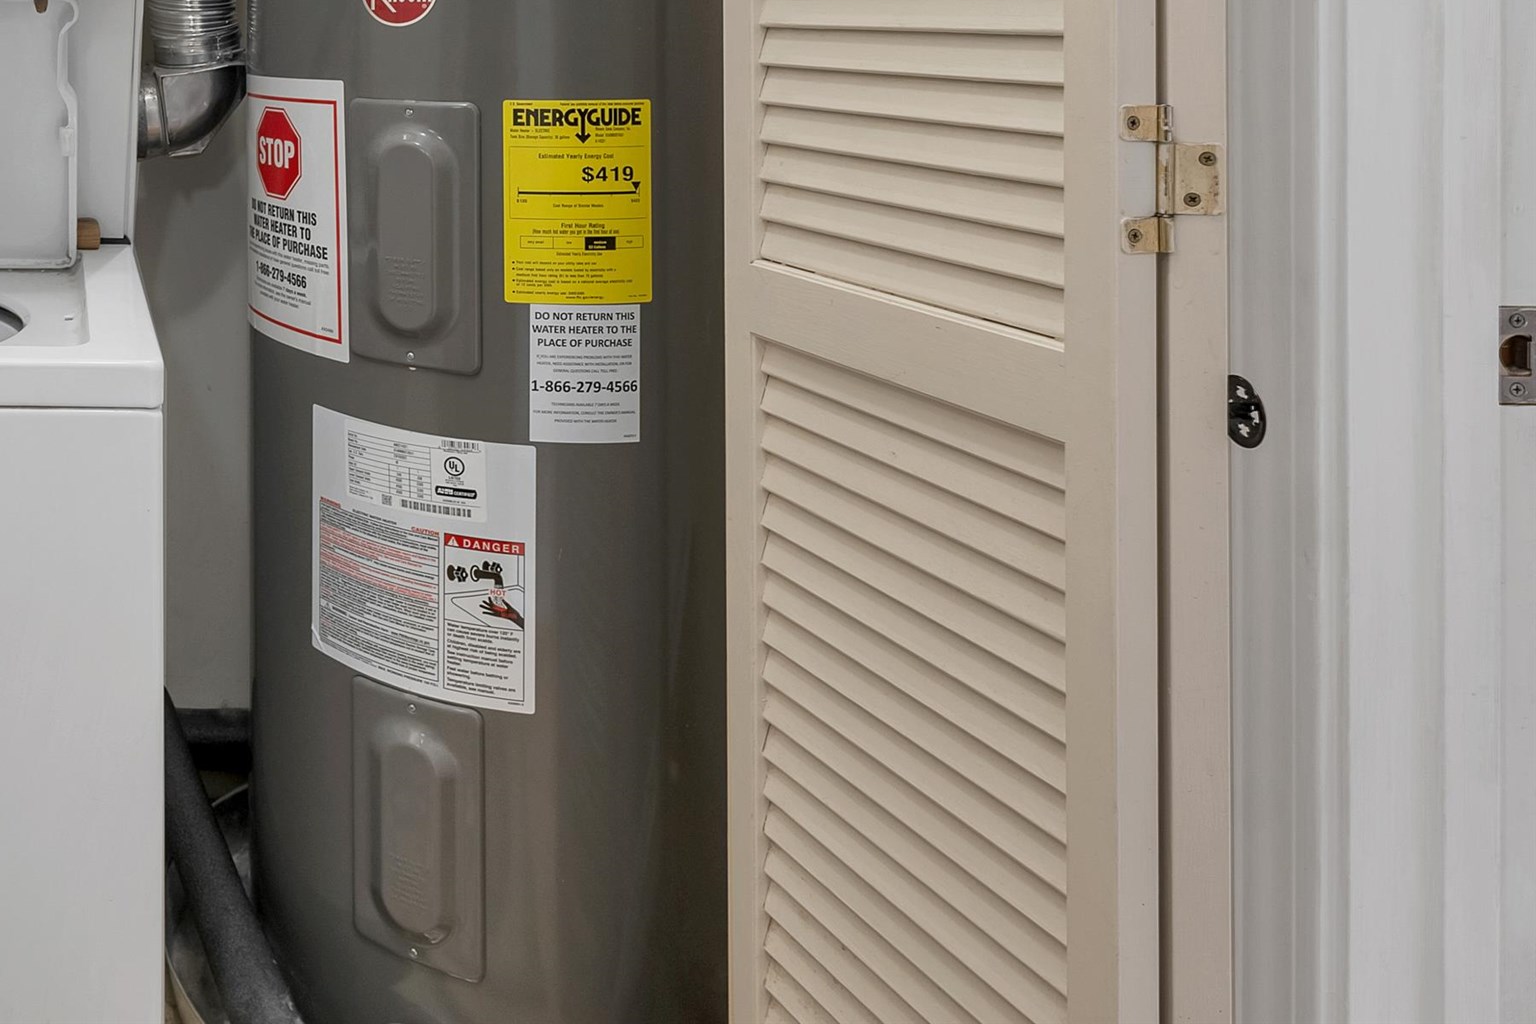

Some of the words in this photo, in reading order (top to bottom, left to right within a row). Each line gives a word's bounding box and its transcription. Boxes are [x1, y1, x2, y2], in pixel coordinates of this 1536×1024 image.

[512, 108, 642, 126] ENERGYGUIDE
[259, 135, 295, 170] STOP
[582, 166, 634, 183] $419
[258, 200, 266, 214] NOT
[268, 203, 295, 222] RETURN
[296, 210, 317, 226] THIS
[254, 213, 269, 230] WATER
[270, 219, 298, 238] HEATER
[300, 226, 311, 241] TO
[256, 228, 271, 246] PLACE
[272, 235, 280, 248] OF
[282, 238, 328, 260] PURCHASE
[256, 260, 307, 288] 1-866-279-4566
[534, 311, 550, 320] DO
[552, 312, 574, 320] NOT
[576, 312, 614, 321] RETURN
[616, 311, 635, 320] THIS
[532, 325, 566, 334] WATER
[568, 326, 604, 334] HEATER
[606, 325, 618, 334] TO
[620, 325, 637, 334] THE
[537, 338, 567, 347] PLACE
[569, 338, 583, 347] OF
[584, 338, 633, 347] PURCHASE
[531, 380, 638, 393] 1-866-279-4566
[449, 461, 460, 473] UL
[410, 526, 440, 536] CAUTION
[463, 538, 520, 554] DANGER
[490, 588, 507, 597] HOT
